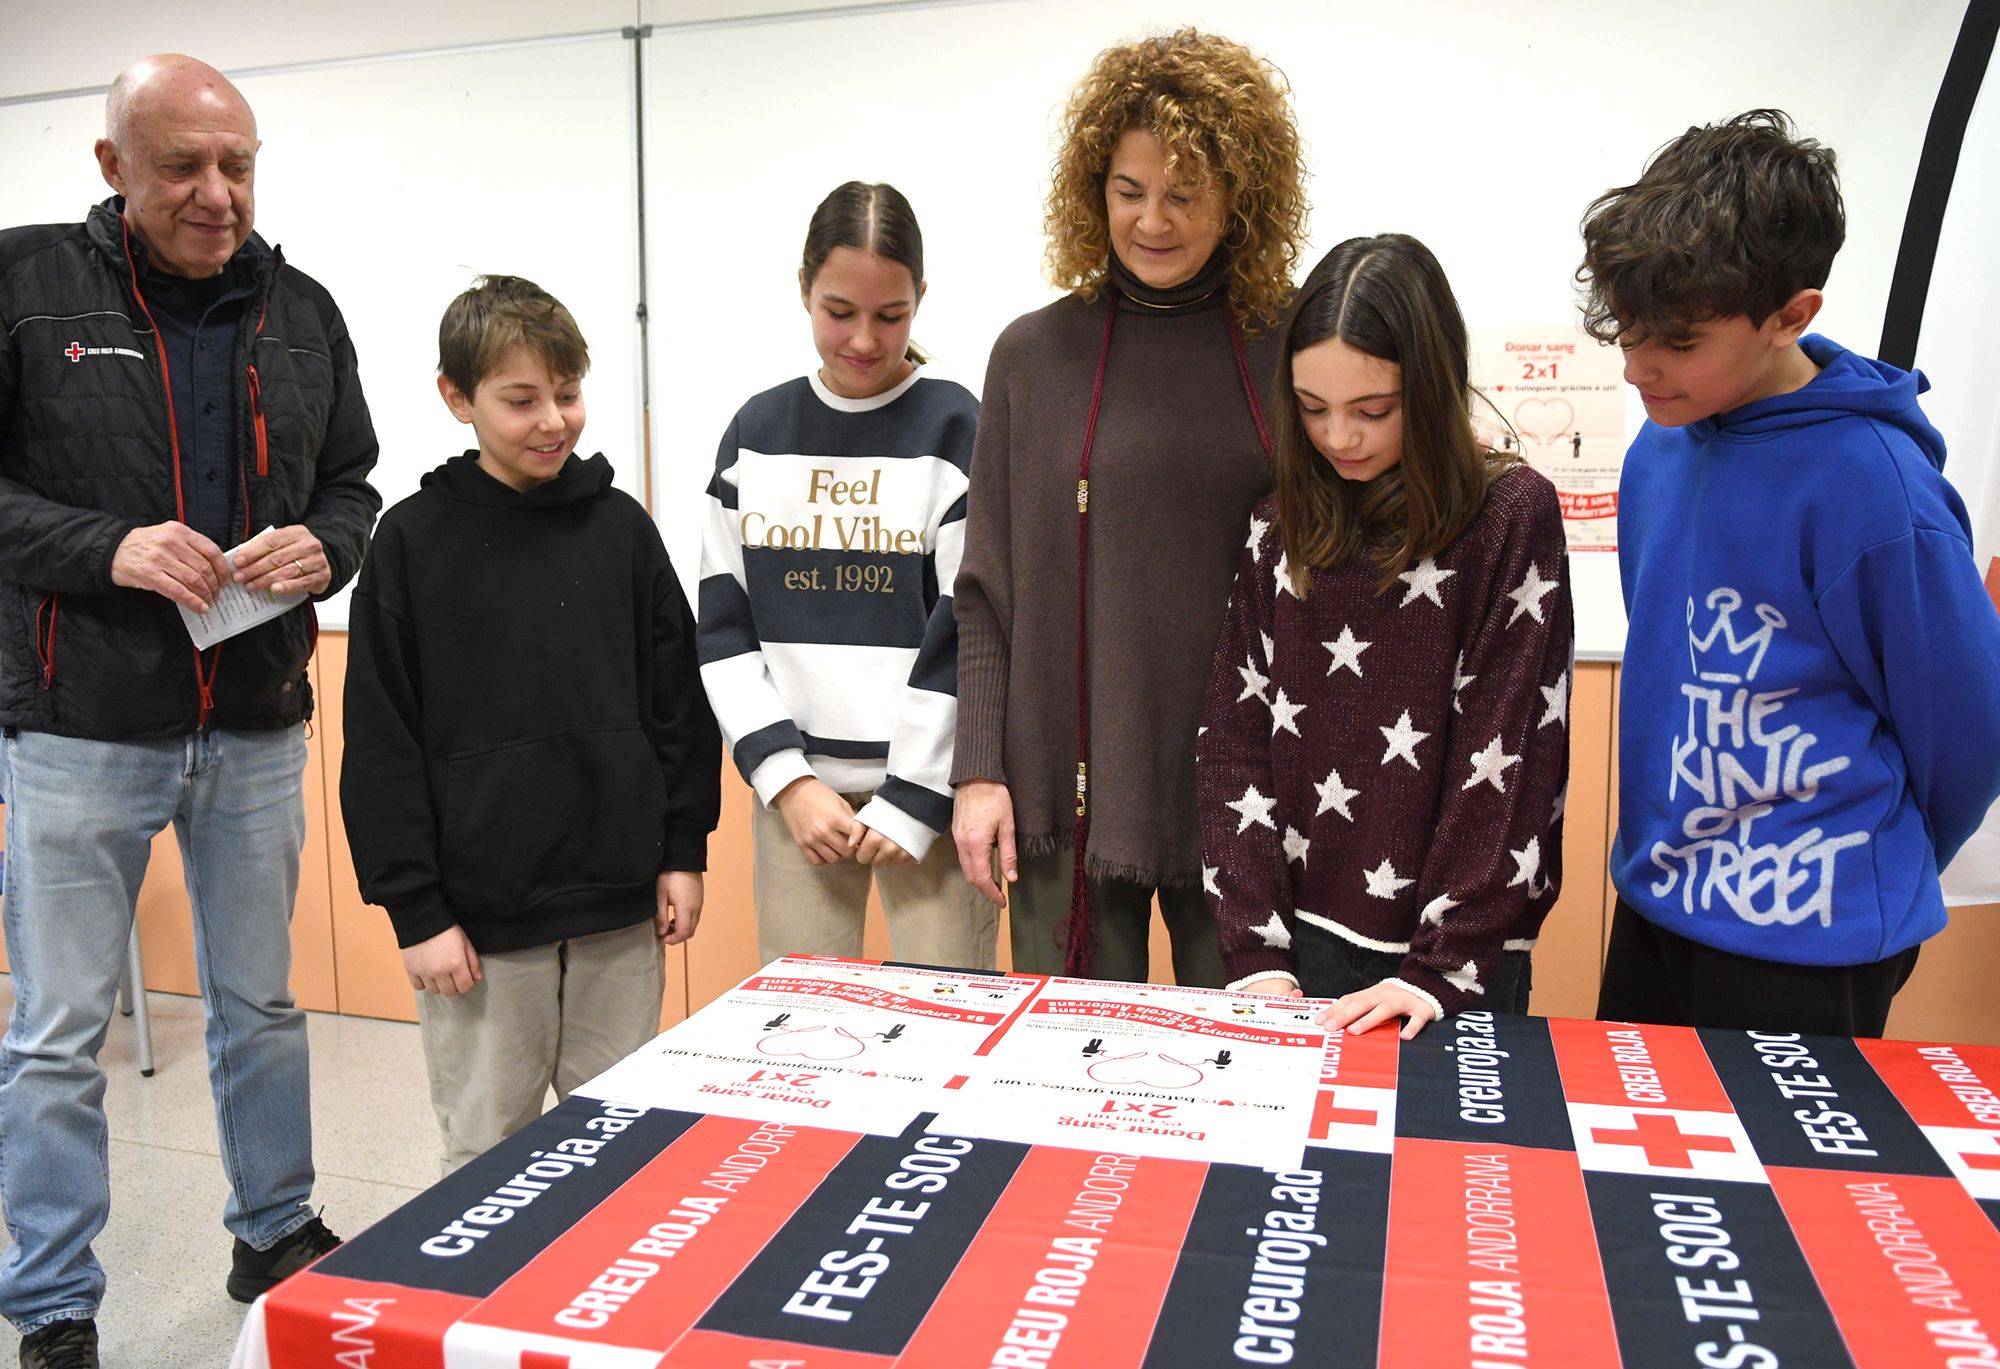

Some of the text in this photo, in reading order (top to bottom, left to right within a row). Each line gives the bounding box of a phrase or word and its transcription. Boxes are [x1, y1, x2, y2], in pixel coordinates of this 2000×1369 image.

[1505, 342, 1576, 354] Donar sang
[1522, 363, 1557, 379] 2x1
[807, 468, 881, 505] Feel
[741, 512, 823, 551] Cool
[784, 564, 895, 593] est. 1992
[1680, 683, 1801, 748] THE
[1669, 733, 1851, 810] KING
[1650, 827, 1870, 928] STREET
[757, 982, 794, 992] sang
[761, 978, 837, 990] Andorrana
[798, 985, 818, 994] de
[819, 989, 875, 1003] donació
[888, 1004, 962, 1021] Campanya
[967, 1014, 987, 1023] 8a
[1047, 1006, 1087, 1015] sang
[1048, 1000, 1132, 1013] Andorrana
[1092, 1009, 1112, 1018] de
[1115, 1011, 1177, 1026] donació
[1135, 1006, 1193, 1024] l'Escola
[1177, 1022, 1197, 1031] de
[1195, 1018, 1215, 1026] de
[1198, 1027, 1281, 1045] Campanya
[1286, 1037, 1307, 1045] 8a
[1603, 1030, 1652, 1065] ROJA
[746, 1070, 821, 1087] 2x1
[767, 1062, 843, 1073] bateguen
[1444, 1010, 1510, 1123] creuroja.ad
[697, 1084, 831, 1109] Donar sang
[1617, 1065, 1668, 1103] CREU
[1916, 1046, 2000, 1125] CREU ROJA
[1101, 1100, 1178, 1118] 2x1
[1110, 1091, 1195, 1103] bateguen
[1116, 1116, 1155, 1124] com
[1771, 1072, 1879, 1157] FES-TE
[1056, 1116, 1205, 1141] Donar sang
[420, 1101, 648, 1257] creuroja.ad
[1464, 1154, 1520, 1274] ANDORRANA
[781, 1136, 974, 1322] FES-TE SOC
[1650, 1192, 1740, 1270] SOCI
[1845, 1182, 1972, 1314] ANDORRANA
[554, 1258, 661, 1329] CREU
[628, 1197, 730, 1258] ROJA
[1024, 1237, 1103, 1307] ROJA
[1233, 1168, 1328, 1364] creuroja.ad
[1469, 1281, 1528, 1357] ROJA
[988, 1307, 1068, 1369] REU
